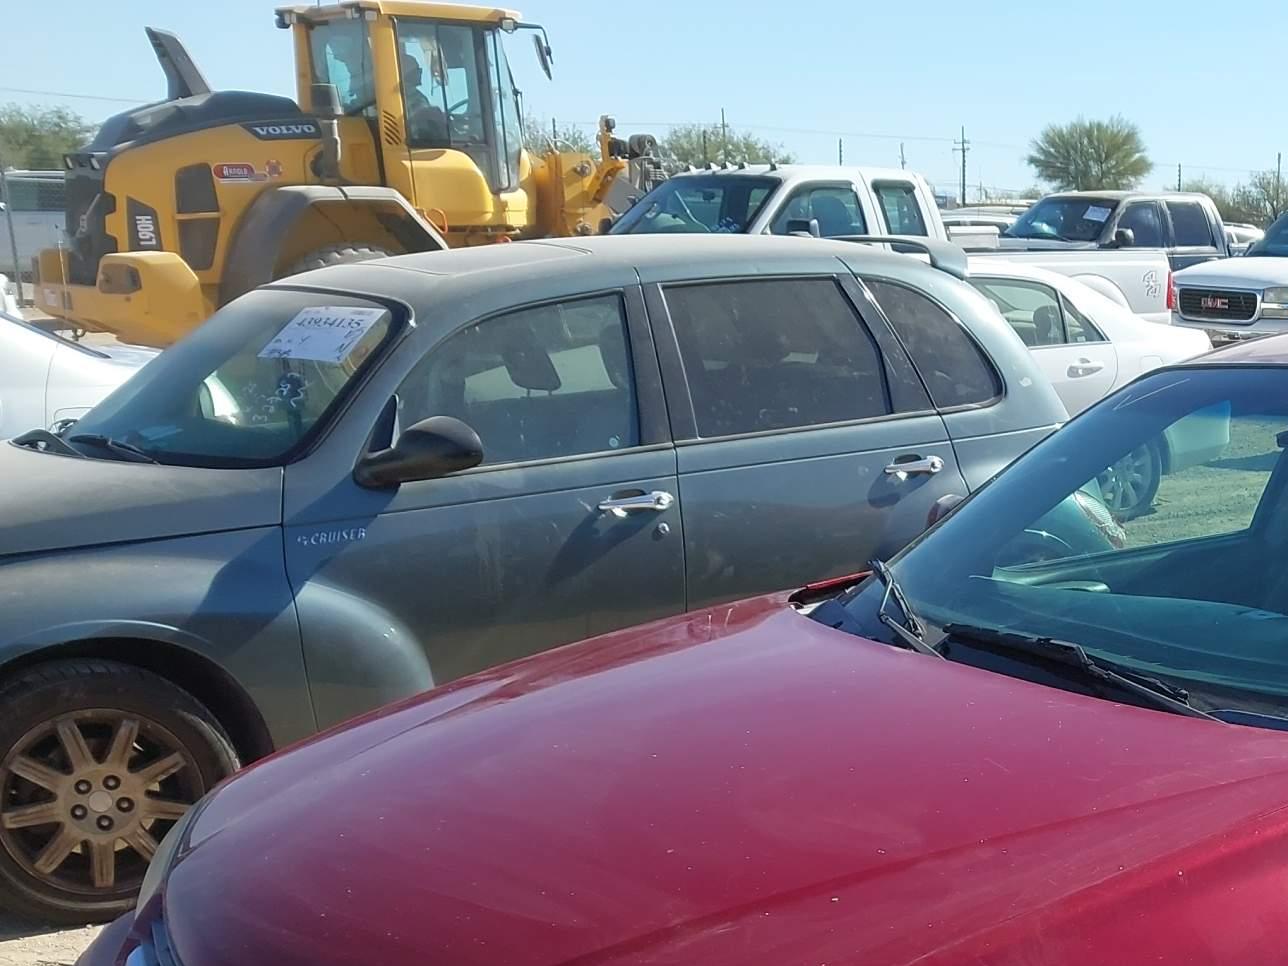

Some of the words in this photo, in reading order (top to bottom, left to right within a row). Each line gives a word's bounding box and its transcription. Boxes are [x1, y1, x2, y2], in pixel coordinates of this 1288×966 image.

[252, 124, 316, 136] VOLVO
[135, 215, 157, 246] L90H
[1200, 296, 1229, 310] GMC
[310, 527, 367, 545] CRUISER
